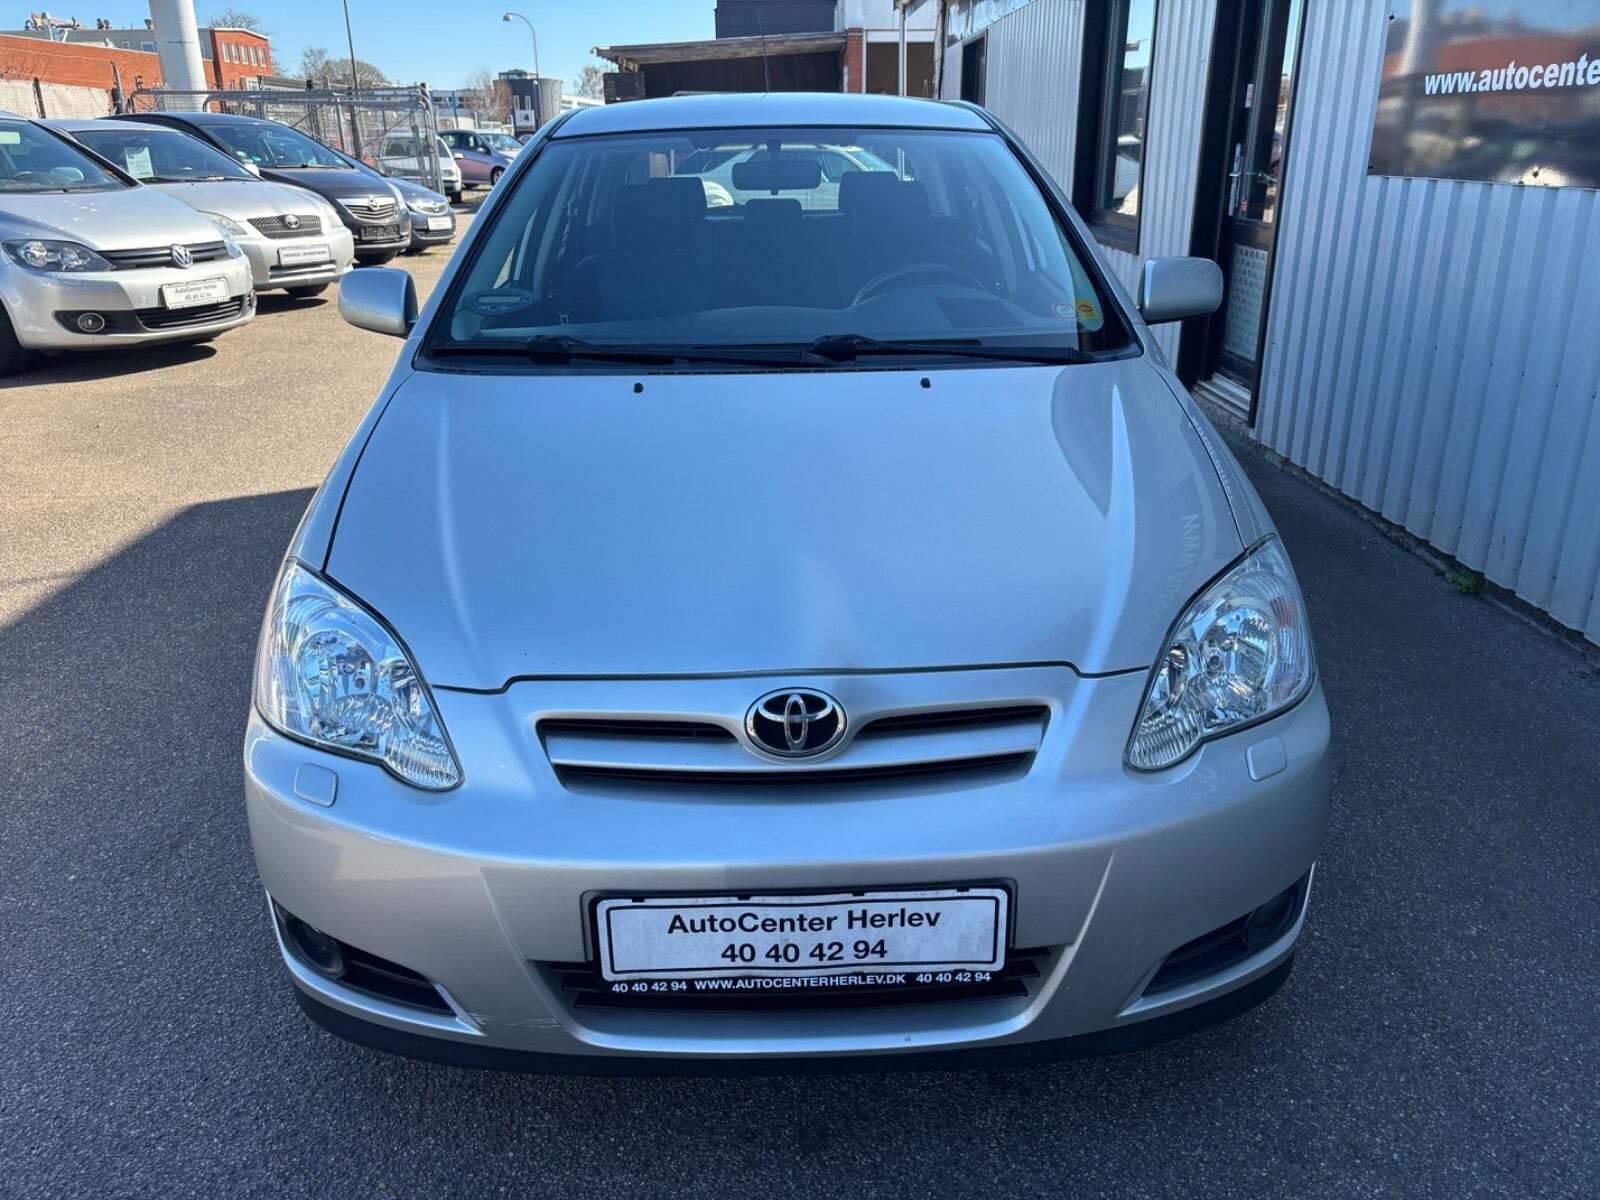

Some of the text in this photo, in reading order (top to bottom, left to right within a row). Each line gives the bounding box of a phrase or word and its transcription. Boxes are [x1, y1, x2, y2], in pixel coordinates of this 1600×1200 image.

[668, 908, 941, 934] AutoCenter Herlev
[721, 939, 888, 963] 40 40 42 94
[612, 972, 991, 993] 40 40 42 94 WWW.AUTOCENTERHERLEV.DK 40 40 42 94
